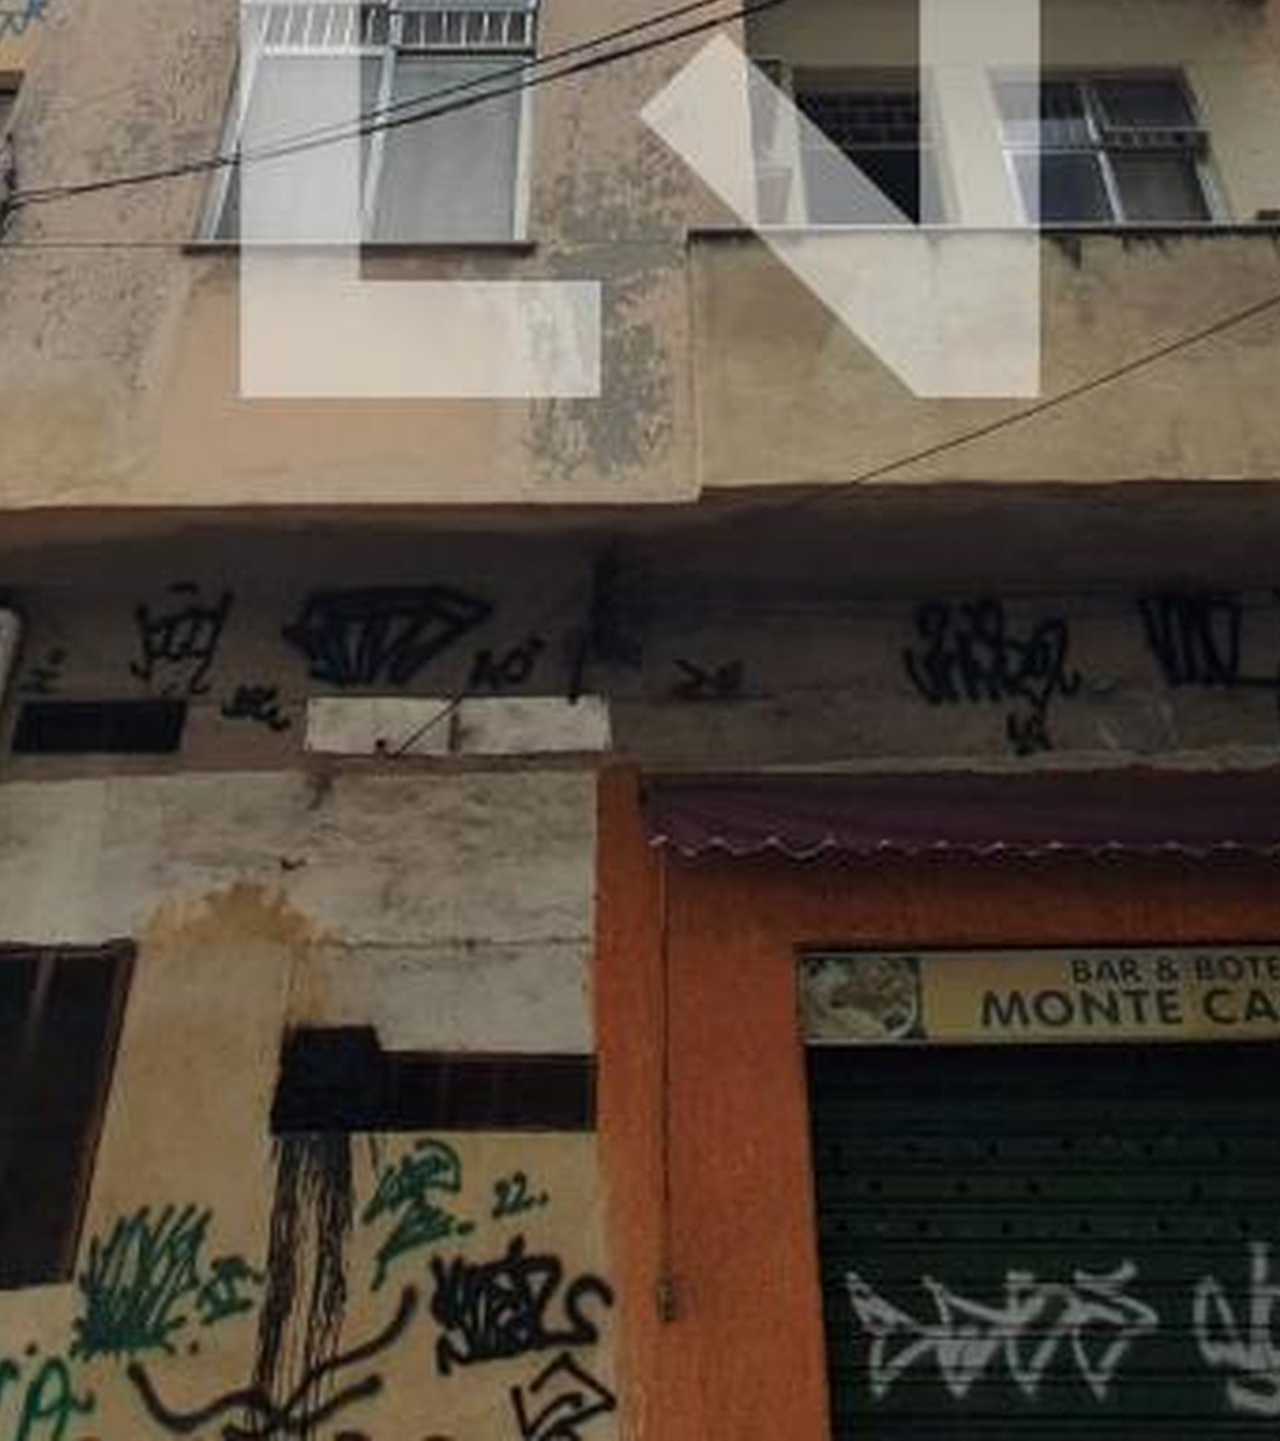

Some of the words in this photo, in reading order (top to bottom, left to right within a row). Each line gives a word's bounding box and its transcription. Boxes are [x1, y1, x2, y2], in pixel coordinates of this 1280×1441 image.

[1072, 958, 1141, 984] BAR
[1155, 958, 1180, 983] &
[981, 988, 1184, 1027] MONTE
